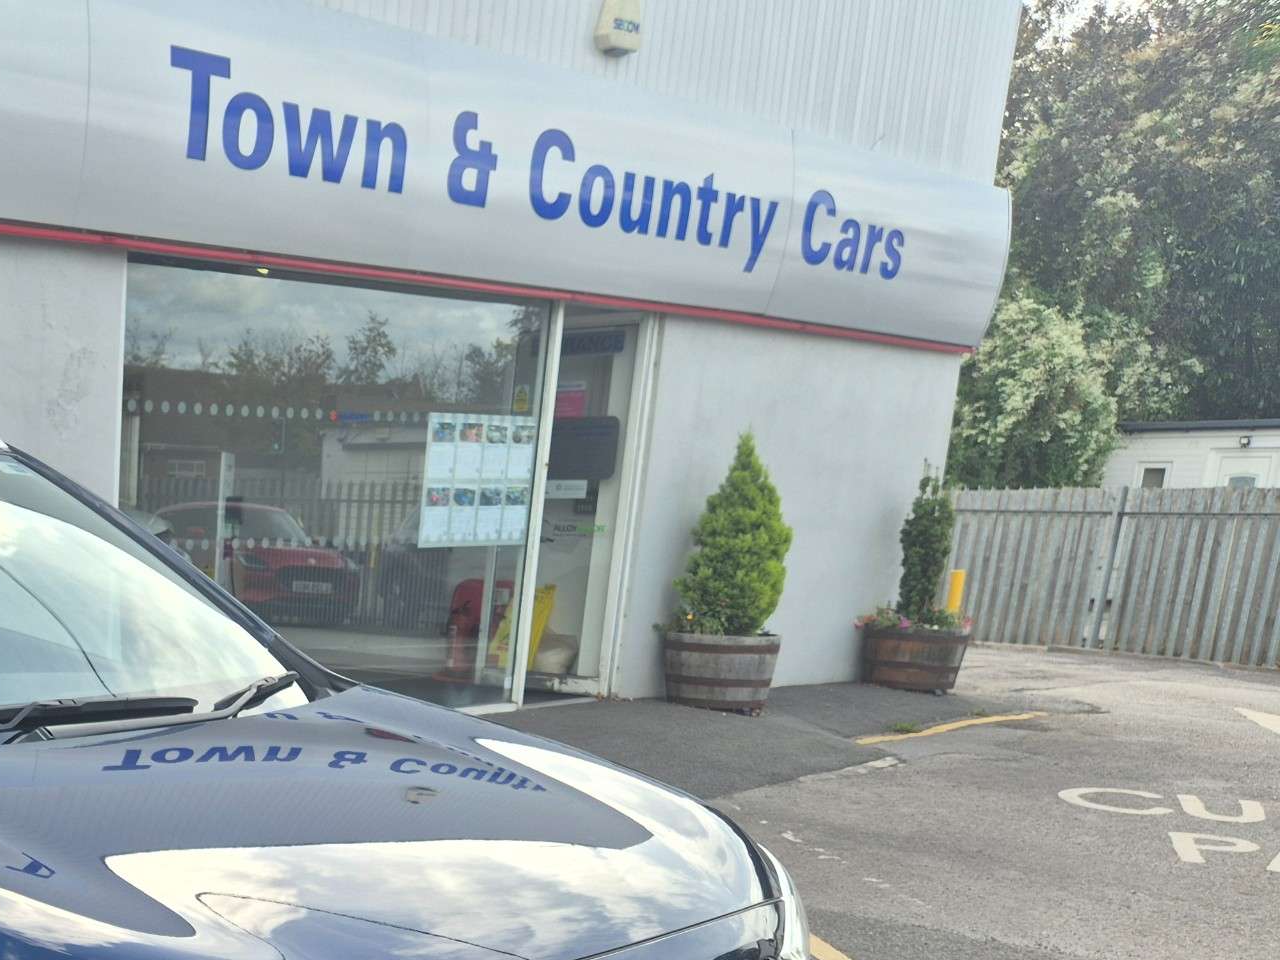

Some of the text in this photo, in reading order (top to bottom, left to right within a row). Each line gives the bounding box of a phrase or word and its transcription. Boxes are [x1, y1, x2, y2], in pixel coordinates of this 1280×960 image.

[170, 44, 904, 280] Town & Country Cars
